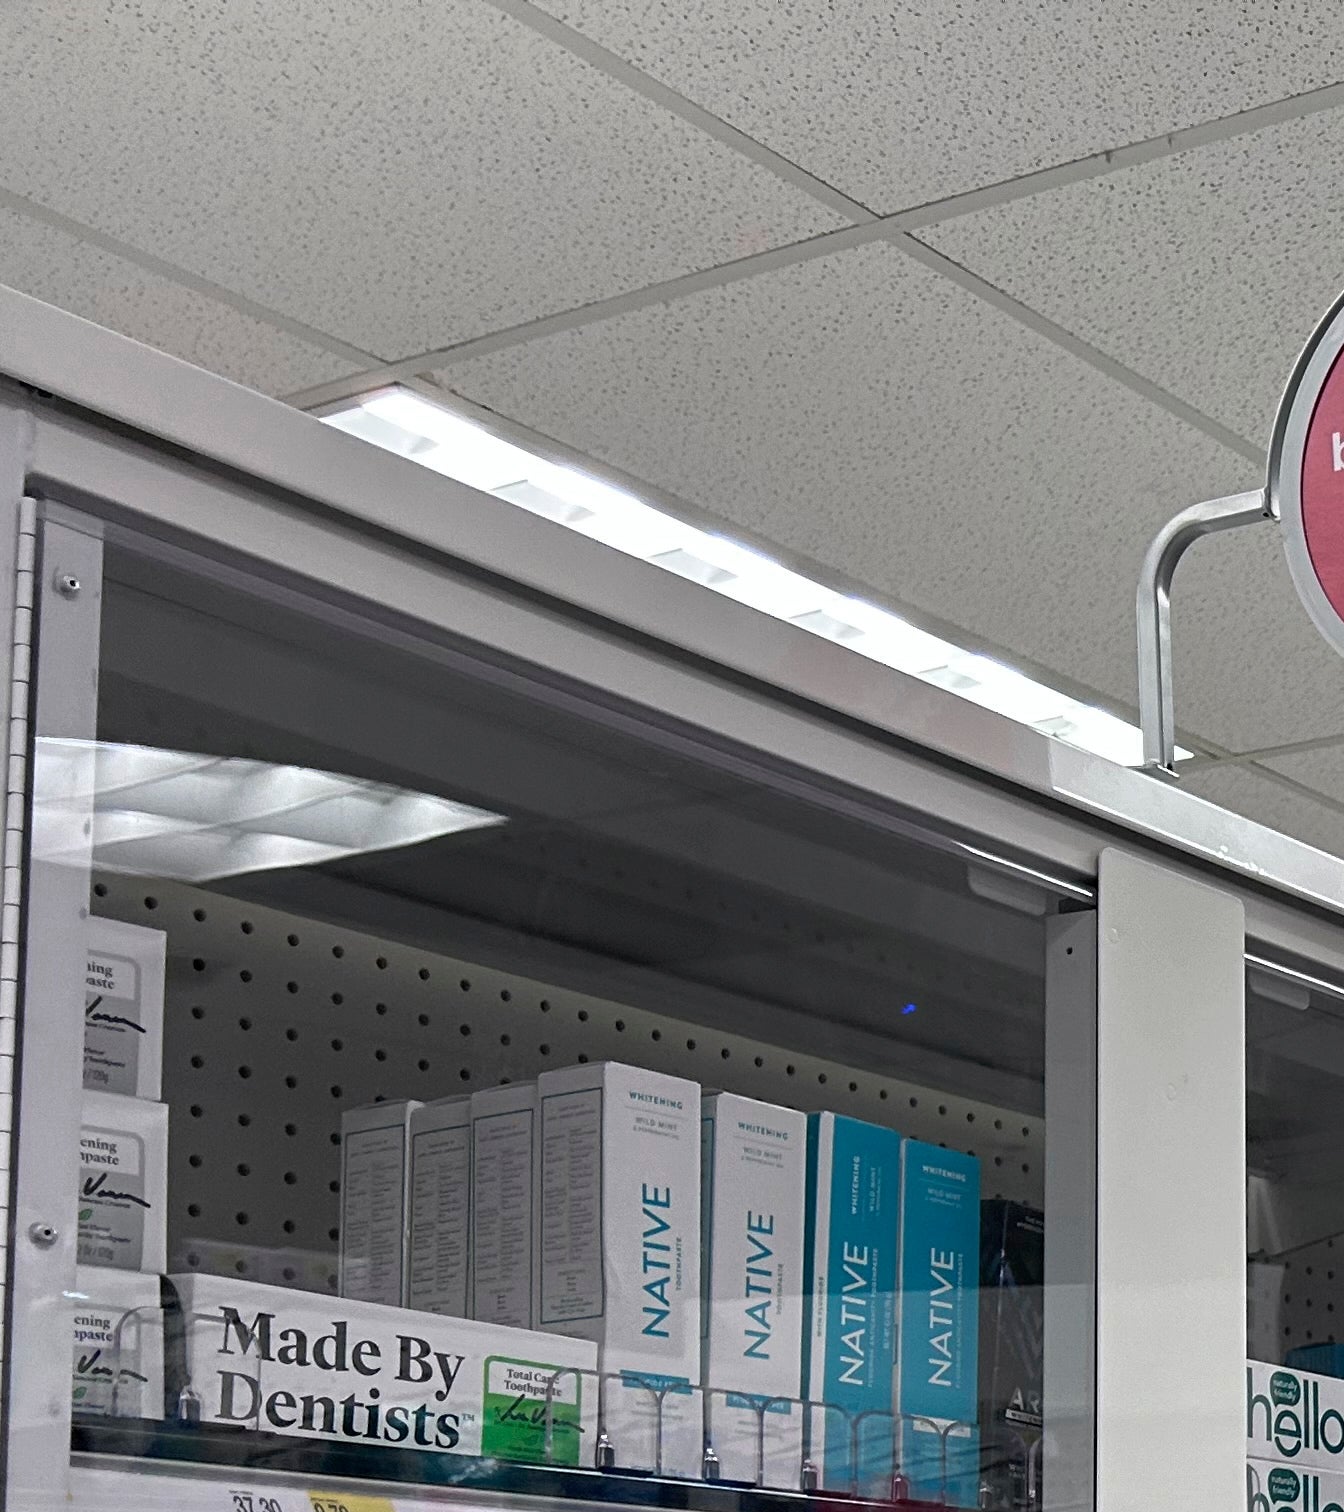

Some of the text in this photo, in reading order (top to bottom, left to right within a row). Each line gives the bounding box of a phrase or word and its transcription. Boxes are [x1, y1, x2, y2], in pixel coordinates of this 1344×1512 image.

[629, 1091, 683, 1110] WHITENING
[738, 1121, 788, 1140] WHITENING
[852, 1156, 861, 1215] WHITENING
[923, 1165, 966, 1183] WHITENING
[641, 1183, 671, 1337] NATIVE
[743, 1210, 774, 1360] NATIVE
[838, 1241, 868, 1385] NATIVE
[928, 1248, 954, 1387] NATIVE
[217, 1306, 465, 1401] Made By
[507, 1368, 532, 1380] Total
[1271, 1476, 1297, 1489] naturally
[1273, 1485, 1296, 1498] friendly
